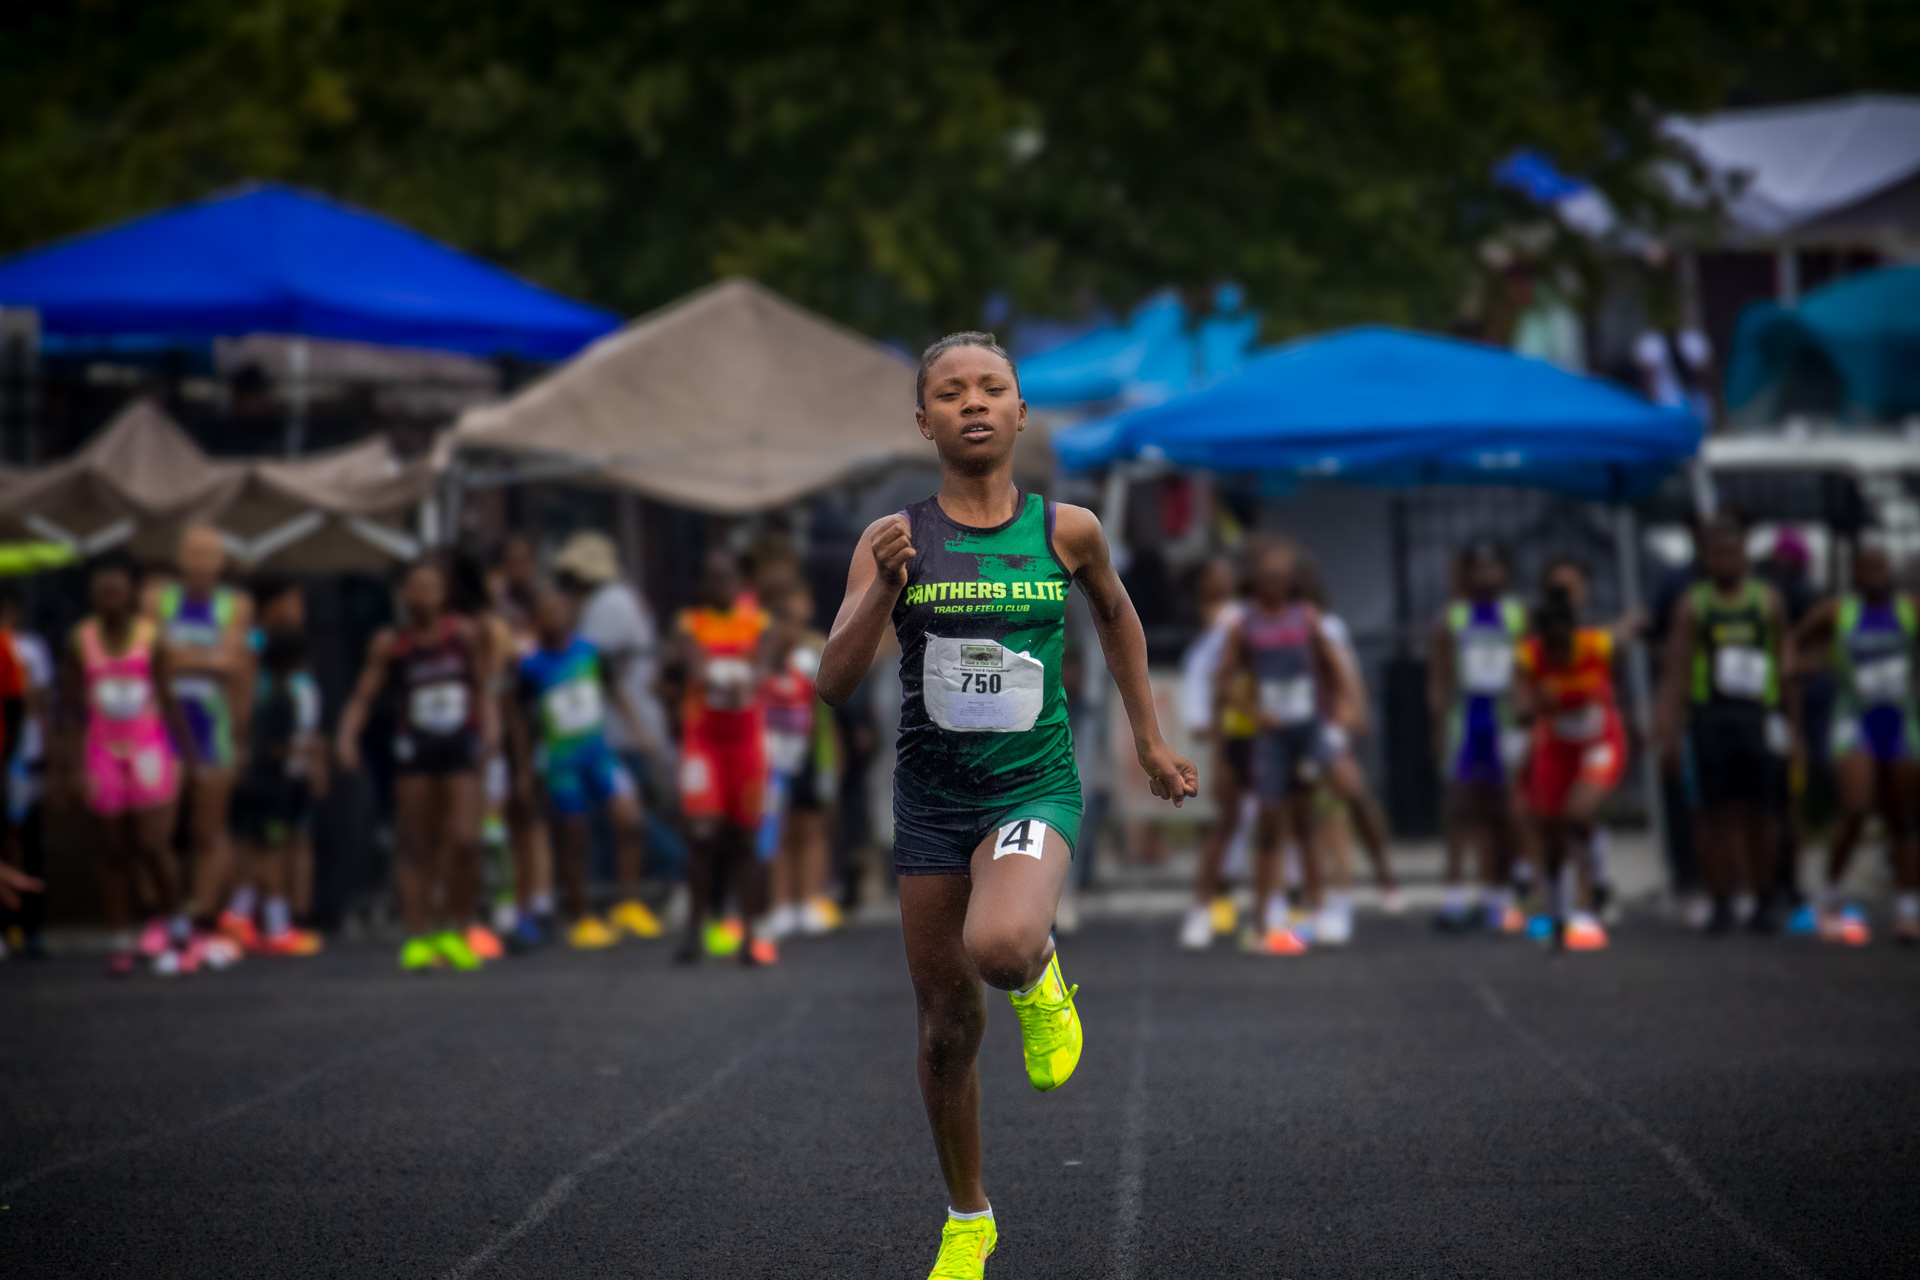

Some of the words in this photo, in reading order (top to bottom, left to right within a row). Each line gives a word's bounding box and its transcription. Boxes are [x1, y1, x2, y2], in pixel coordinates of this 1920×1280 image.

[906, 582, 1006, 606] PANTHERS
[1012, 581, 1064, 601] ELITE
[934, 605, 965, 614] TRACK
[966, 605, 973, 613] &
[975, 604, 1004, 613] FIELD
[1005, 604, 1031, 613] CLUB
[961, 673, 1002, 694] 750
[1001, 820, 1034, 851] 4
